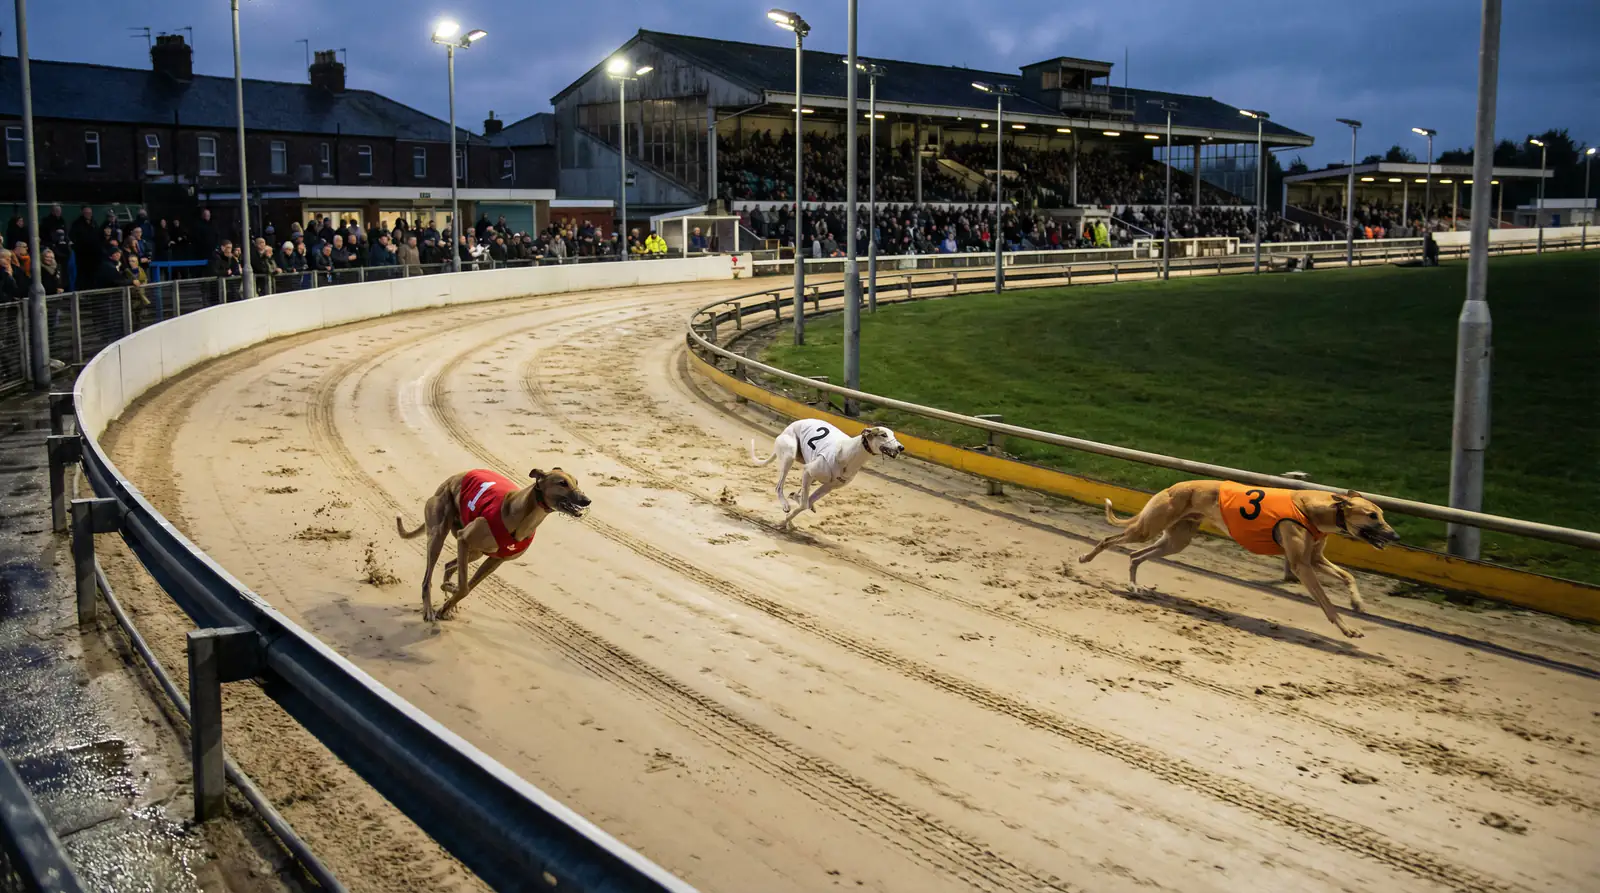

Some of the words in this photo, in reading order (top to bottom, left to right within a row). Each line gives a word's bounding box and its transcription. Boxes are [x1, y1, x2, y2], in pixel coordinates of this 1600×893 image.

[807, 427, 830, 450] 2
[467, 481, 497, 512] 1
[1240, 489, 1265, 520] 3
